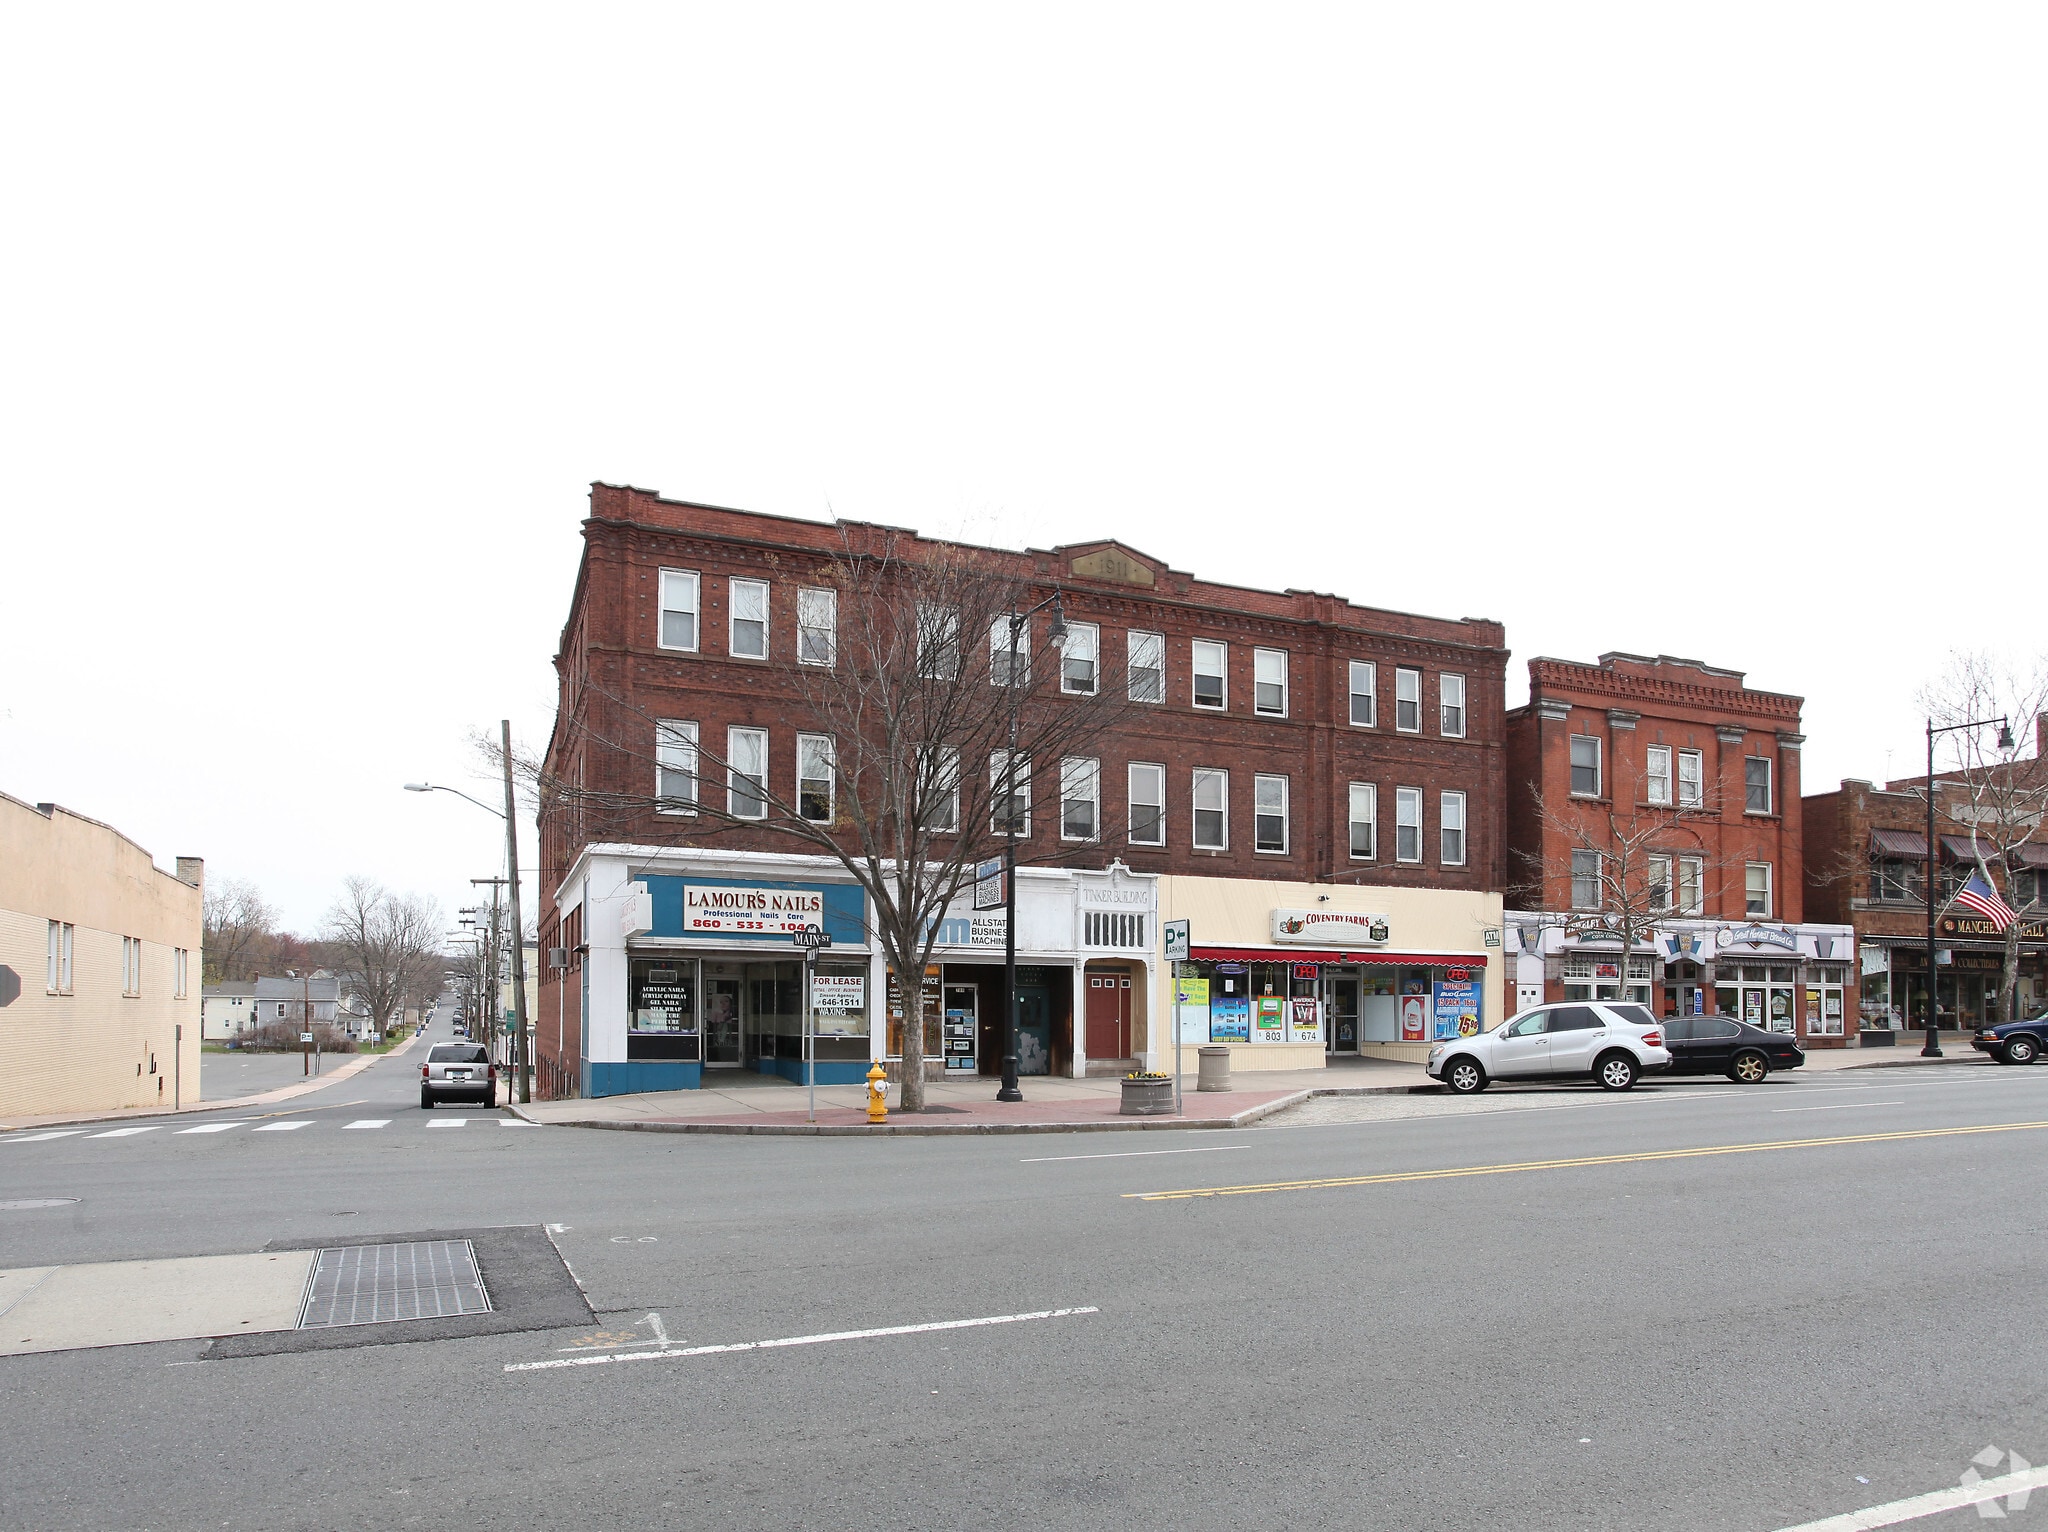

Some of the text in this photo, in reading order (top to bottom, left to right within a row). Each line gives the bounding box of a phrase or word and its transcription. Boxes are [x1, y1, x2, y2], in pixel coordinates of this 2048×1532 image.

[1100, 559, 1128, 577] 1911
[979, 881, 998, 891] ALLSTATE
[978, 888, 999, 898] BUSINESS
[1113, 889, 1148, 904] BUILDING
[688, 891, 820, 911] LAMOUR'S NAILS
[978, 896, 999, 906] MACHINES
[703, 910, 753, 918] Professional
[692, 919, 721, 928] 860
[736, 921, 764, 929] 533
[780, 922, 806, 931] 104
[972, 918, 1007, 927] ALLSTAT
[1306, 913, 1345, 924] COVENTRY
[1346, 915, 1370, 928] FARMS
[972, 928, 1007, 936] BUSINES
[1486, 930, 1500, 940] ATM
[1734, 930, 1750, 940] Great
[1750, 928, 1770, 940] Harvest
[1770, 932, 1786, 944] Bread
[794, 933, 819, 946] MAIN
[1957, 959, 2000, 968] COLLECTIBLES
[1296, 966, 1316, 978] OPEN
[1446, 969, 1470, 980] OPEN
[833, 978, 862, 986] LEASE
[1437, 998, 1444, 1006] 15
[1446, 998, 1460, 1006] PACK
[818, 1008, 847, 1016] WAXING
[1266, 1032, 1281, 1040] 803
[1302, 1032, 1316, 1040] 674
